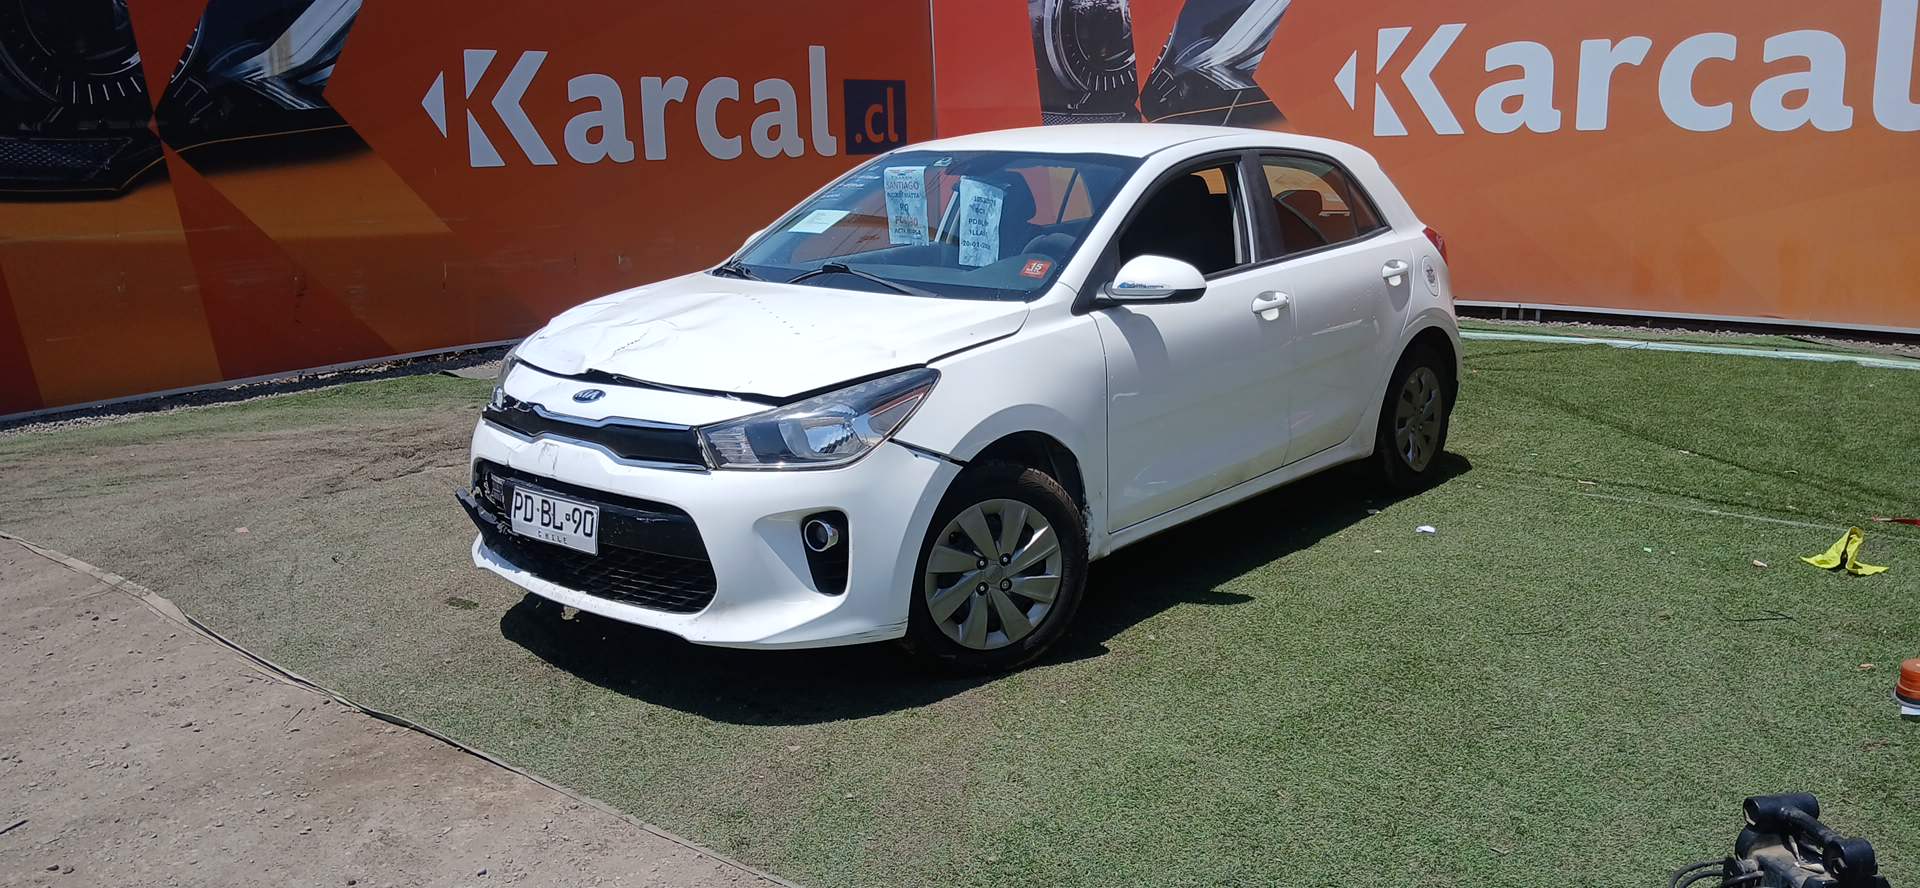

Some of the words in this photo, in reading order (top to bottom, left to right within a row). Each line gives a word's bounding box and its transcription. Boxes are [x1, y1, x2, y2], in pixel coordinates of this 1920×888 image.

[1373, 0, 1920, 137] Karcal
[463, 45, 837, 168] Karcal
[886, 180, 920, 191] SANTIAGO
[575, 390, 601, 400] KIA
[537, 530, 569, 545] CHILE
